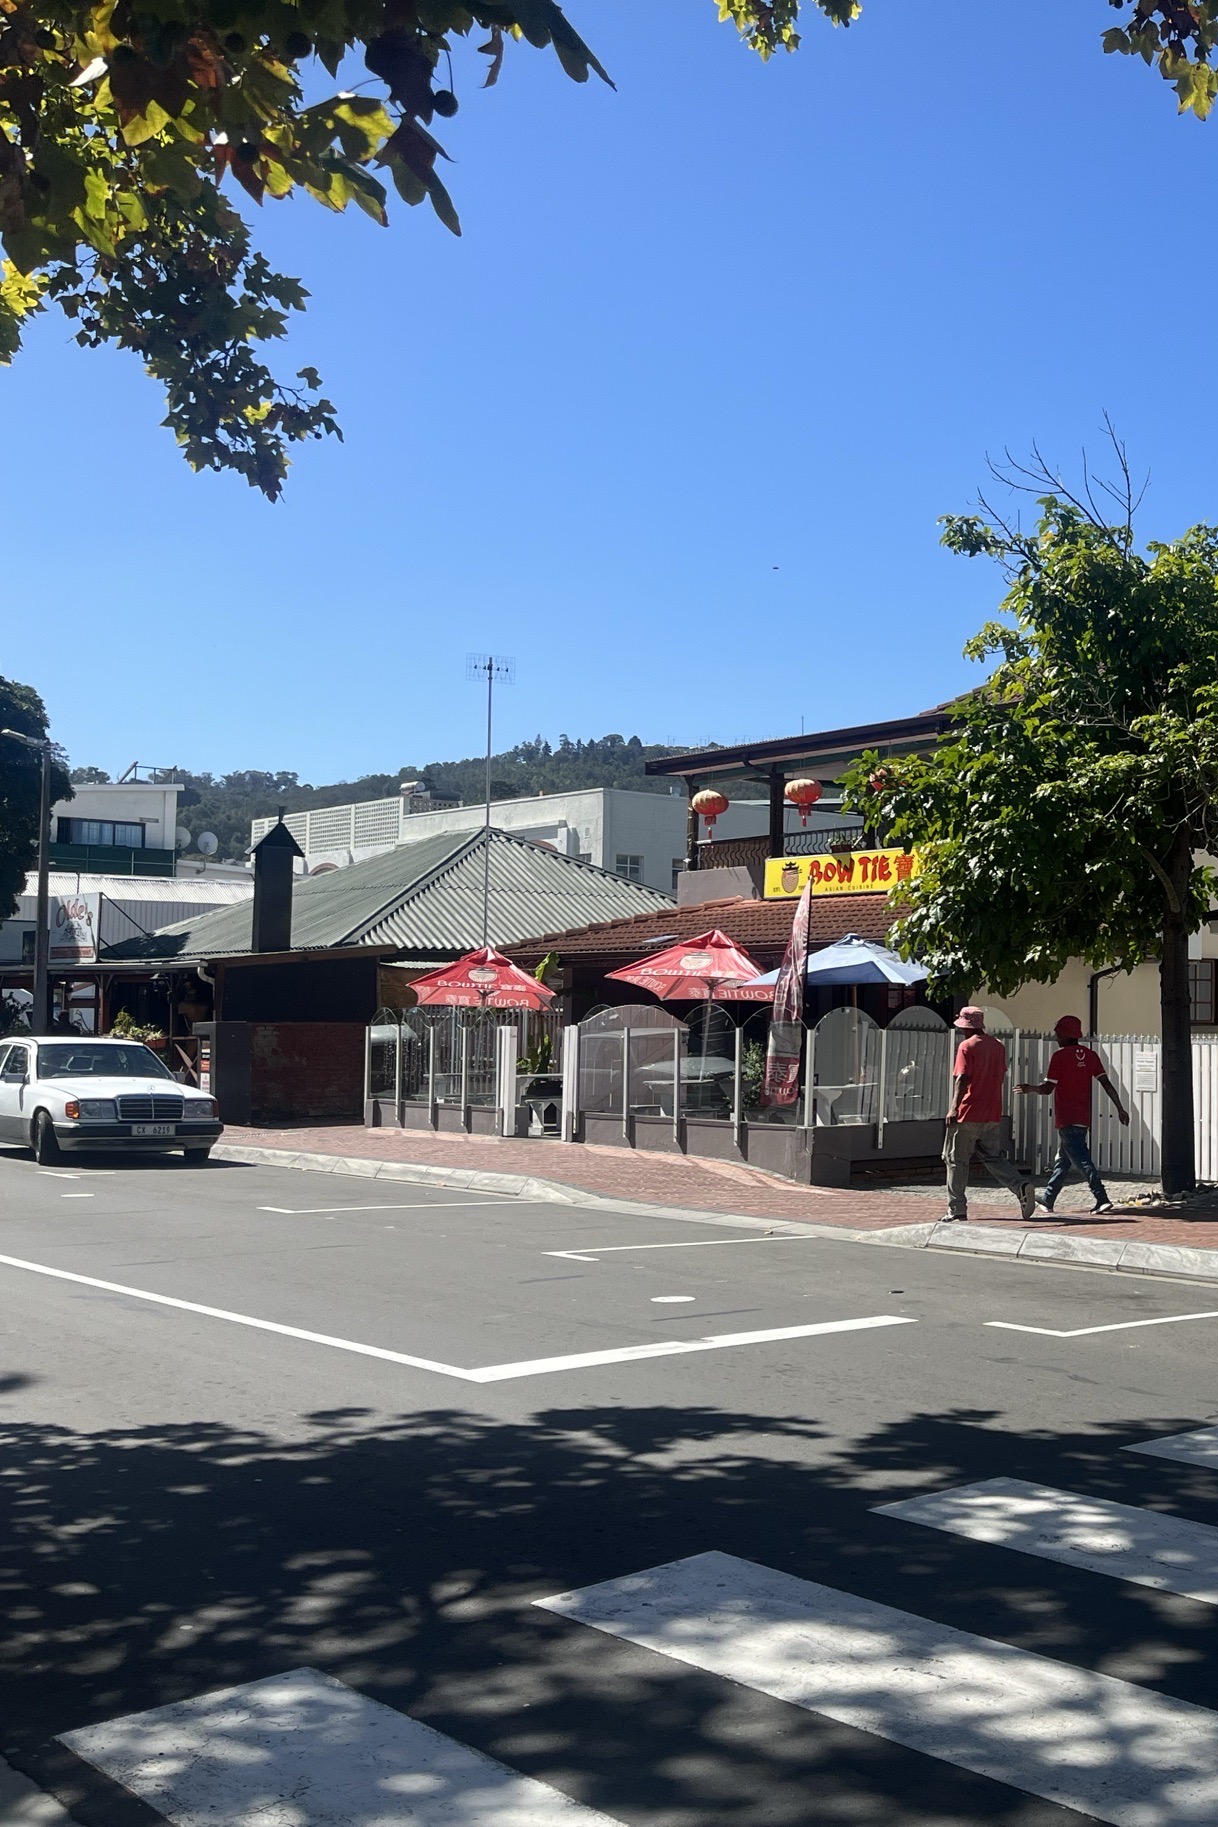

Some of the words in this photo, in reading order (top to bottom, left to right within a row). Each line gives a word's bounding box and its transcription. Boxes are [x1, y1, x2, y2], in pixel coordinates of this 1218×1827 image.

[809, 858, 855, 886] BOW
[858, 854, 892, 884] TIE
[847, 883, 874, 891] CUISINE
[640, 967, 707, 977] BOWTIE
[136, 1126, 146, 1134] CX
[152, 1126, 171, 1134] 6219
